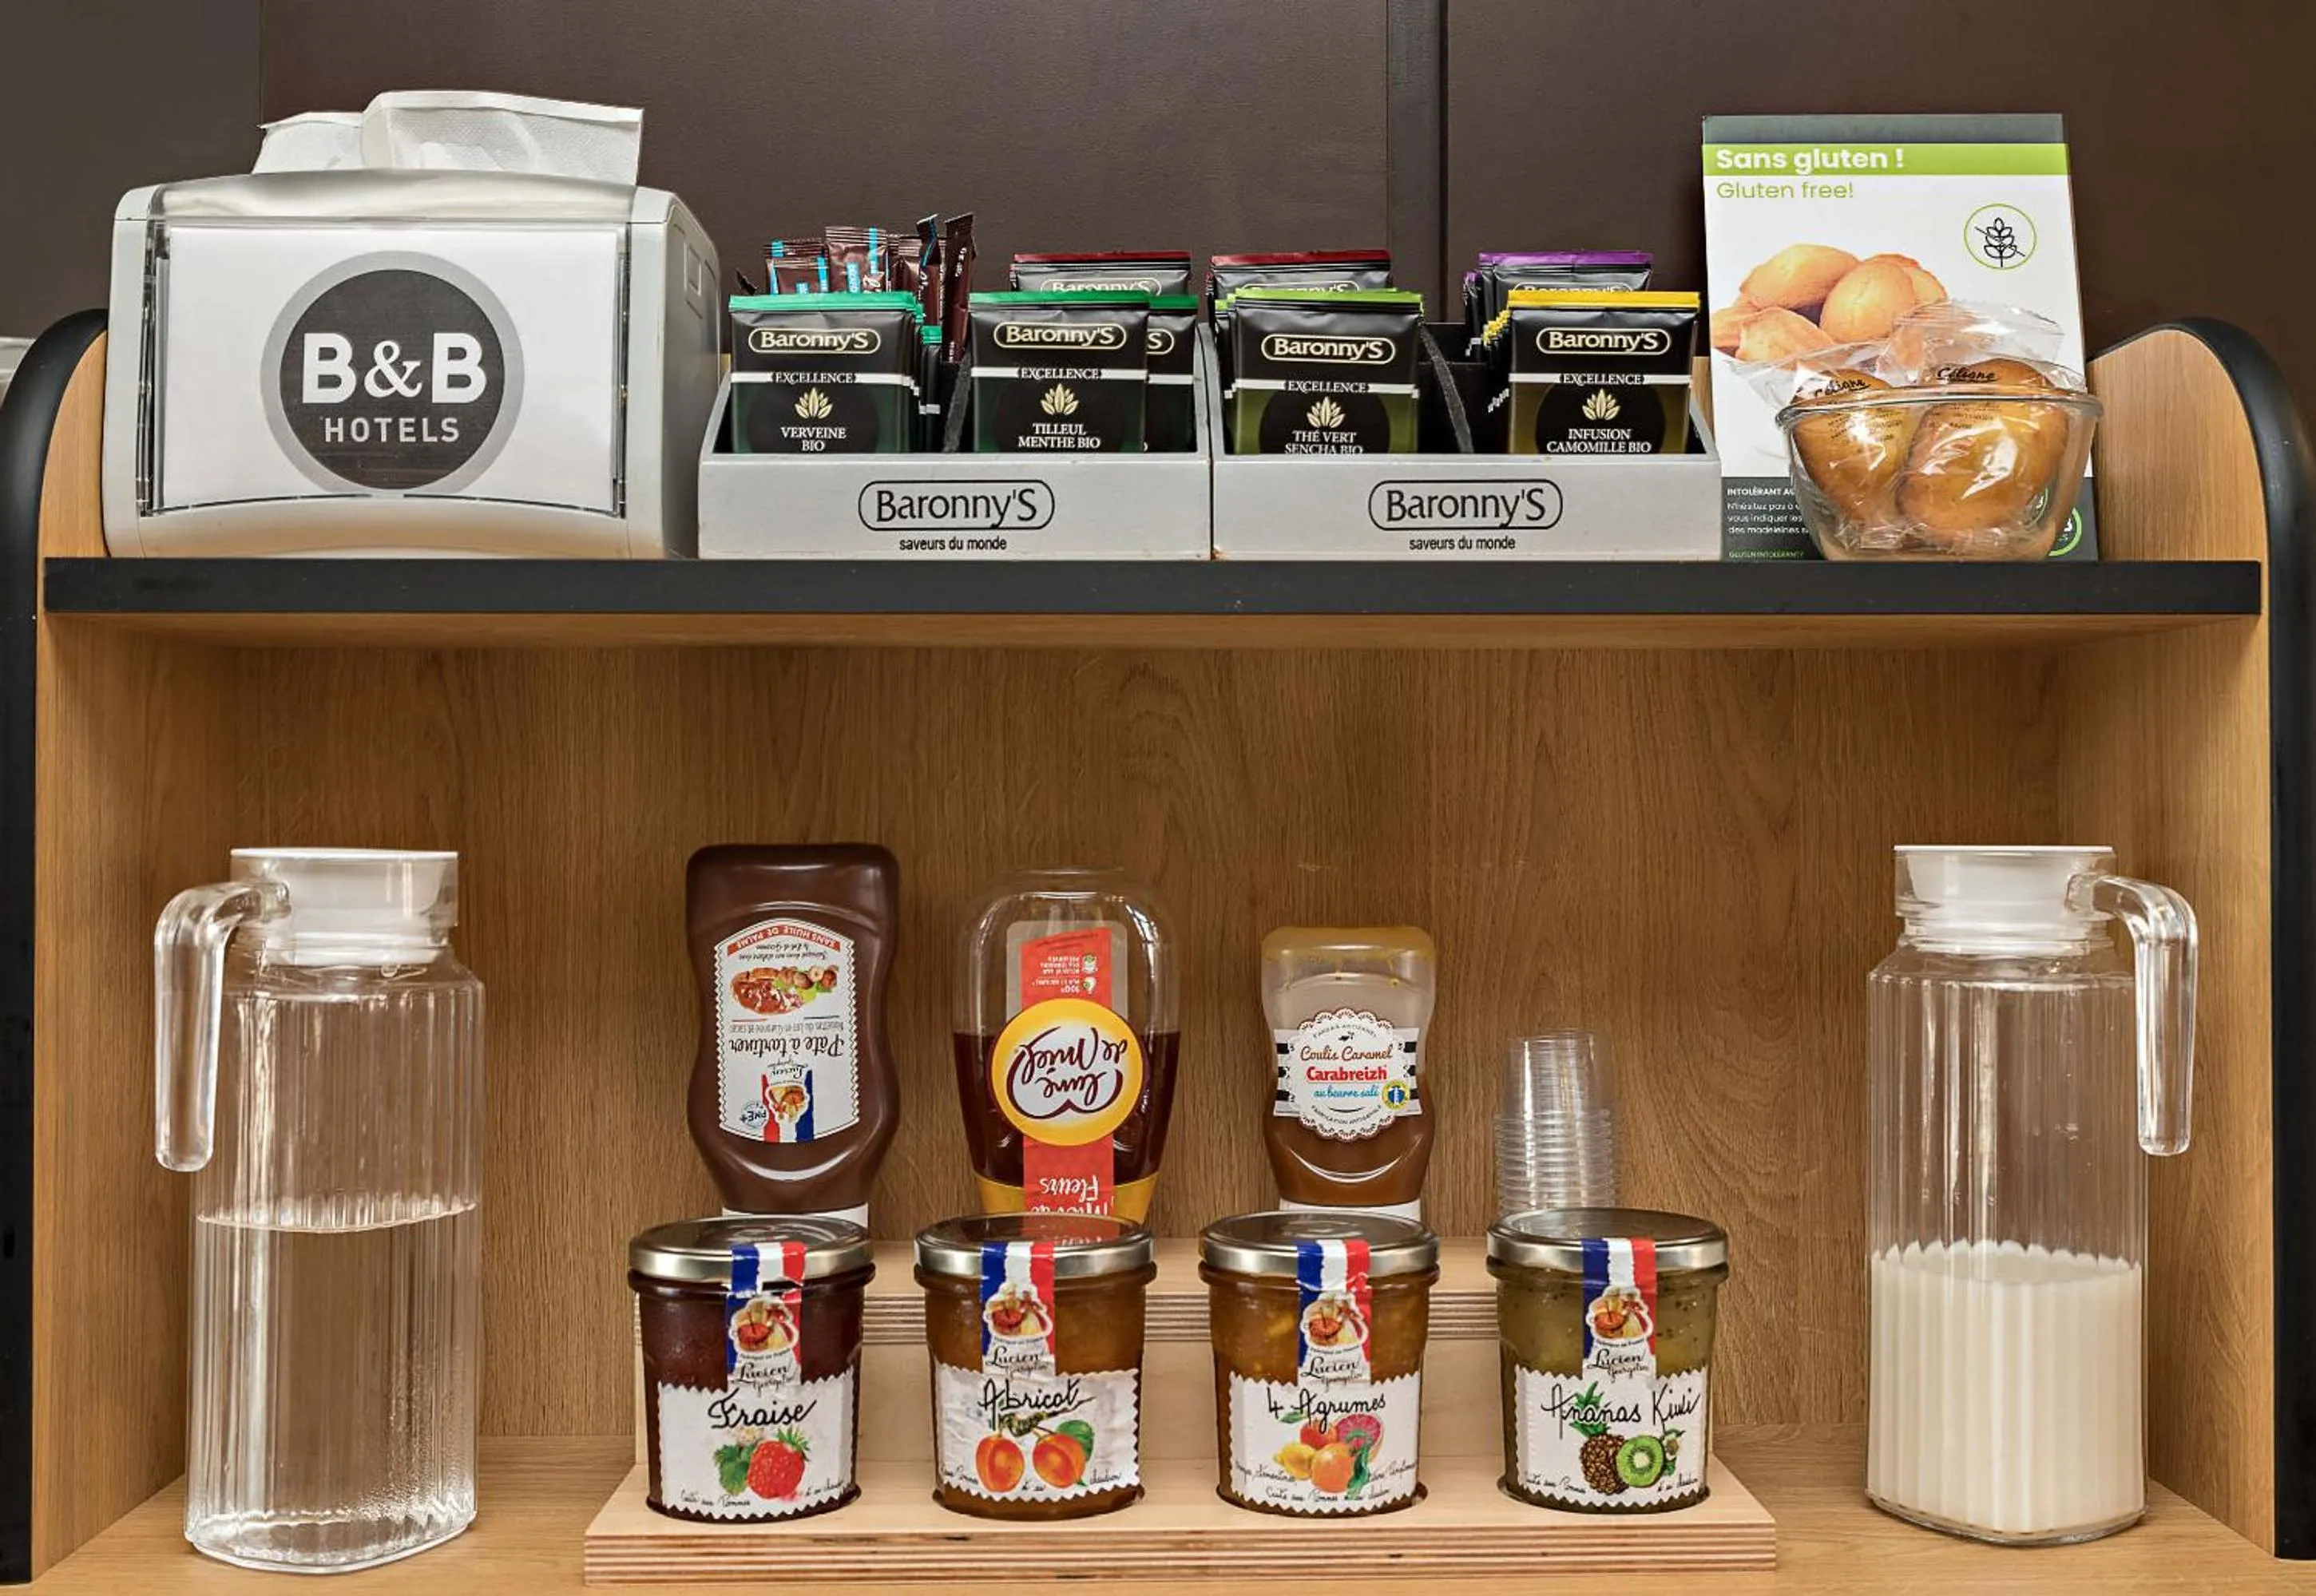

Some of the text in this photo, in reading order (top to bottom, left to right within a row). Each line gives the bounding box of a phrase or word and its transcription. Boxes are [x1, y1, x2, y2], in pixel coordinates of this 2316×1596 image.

[1716, 148, 1904, 175] Sans gluten !
[1717, 181, 1854, 199] Gluten free!
[760, 331, 869, 351] Baronny'S
[1005, 326, 1116, 347] Baronny'S
[1549, 331, 1658, 351] Baronny'S
[1274, 338, 1384, 360] Baronny'S
[302, 332, 487, 403] B&B
[1021, 367, 1099, 380] EXCELLENCE
[775, 372, 853, 385] EXCELLENCE
[1287, 380, 1367, 394] EXCELLENCE
[1563, 374, 1642, 386] EXCELLENCE
[324, 418, 460, 442] HOTELS
[780, 426, 847, 439] VERVEINE
[1033, 423, 1086, 435] TILLEUL
[1292, 430, 1357, 443] THÉ VERT
[1568, 429, 1632, 440] INFUSION
[802, 440, 826, 451] BIO
[1018, 436, 1101, 449] MENTHE BIO
[1284, 443, 1364, 454] SENCHA BIO
[1546, 442, 1652, 453] CAMOMILLE BIO
[877, 488, 1037, 529] Baronny'S
[1386, 488, 1546, 529] Baronny'S
[899, 537, 1007, 550] saveurs du monde
[1409, 536, 1516, 549] saveurs du monde
[728, 1034, 845, 1058] Pâte à tartiner
[1101, 1039, 1128, 1063] de
[1300, 1043, 1394, 1062] Coulis Caramel
[1306, 1066, 1388, 1081] Carabreizh
[1038, 1174, 1100, 1203] Fleurs
[984, 1345, 1041, 1368] Lucien
[1586, 1348, 1645, 1369] Lucien
[1300, 1356, 1359, 1379] Lucien
[708, 1388, 817, 1429] Fraise
[978, 1378, 1080, 1431] Abricot
[1266, 1387, 1386, 1434] 4 Agrumes
[1541, 1383, 1700, 1440] Ananas Kiwi
